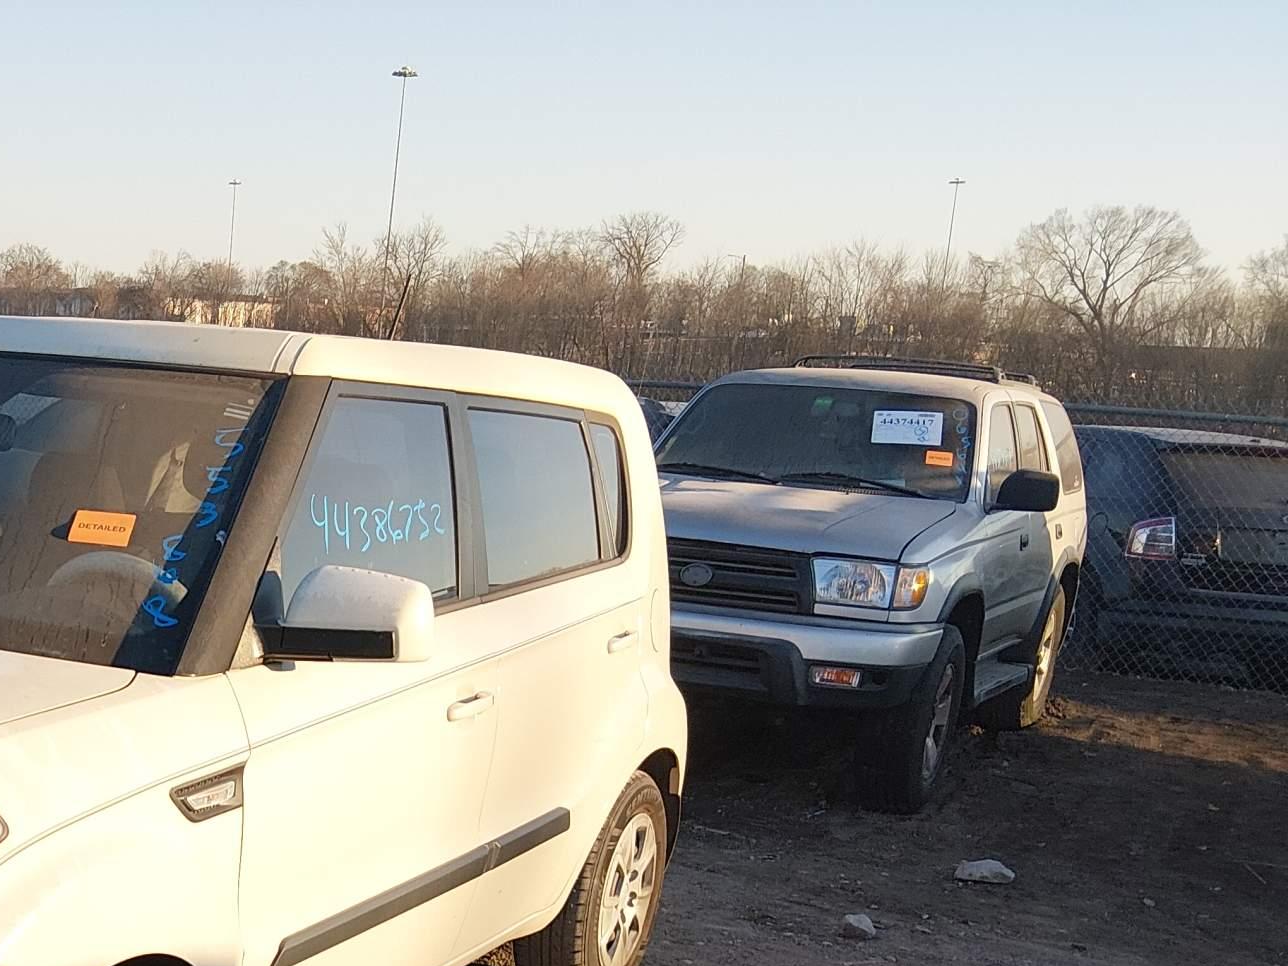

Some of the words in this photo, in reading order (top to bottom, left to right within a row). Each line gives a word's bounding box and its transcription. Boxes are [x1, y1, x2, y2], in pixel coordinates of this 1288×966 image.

[879, 418, 935, 426] 44374417
[78, 522, 127, 533] DETAILED
[310, 494, 445, 555] 44386752
